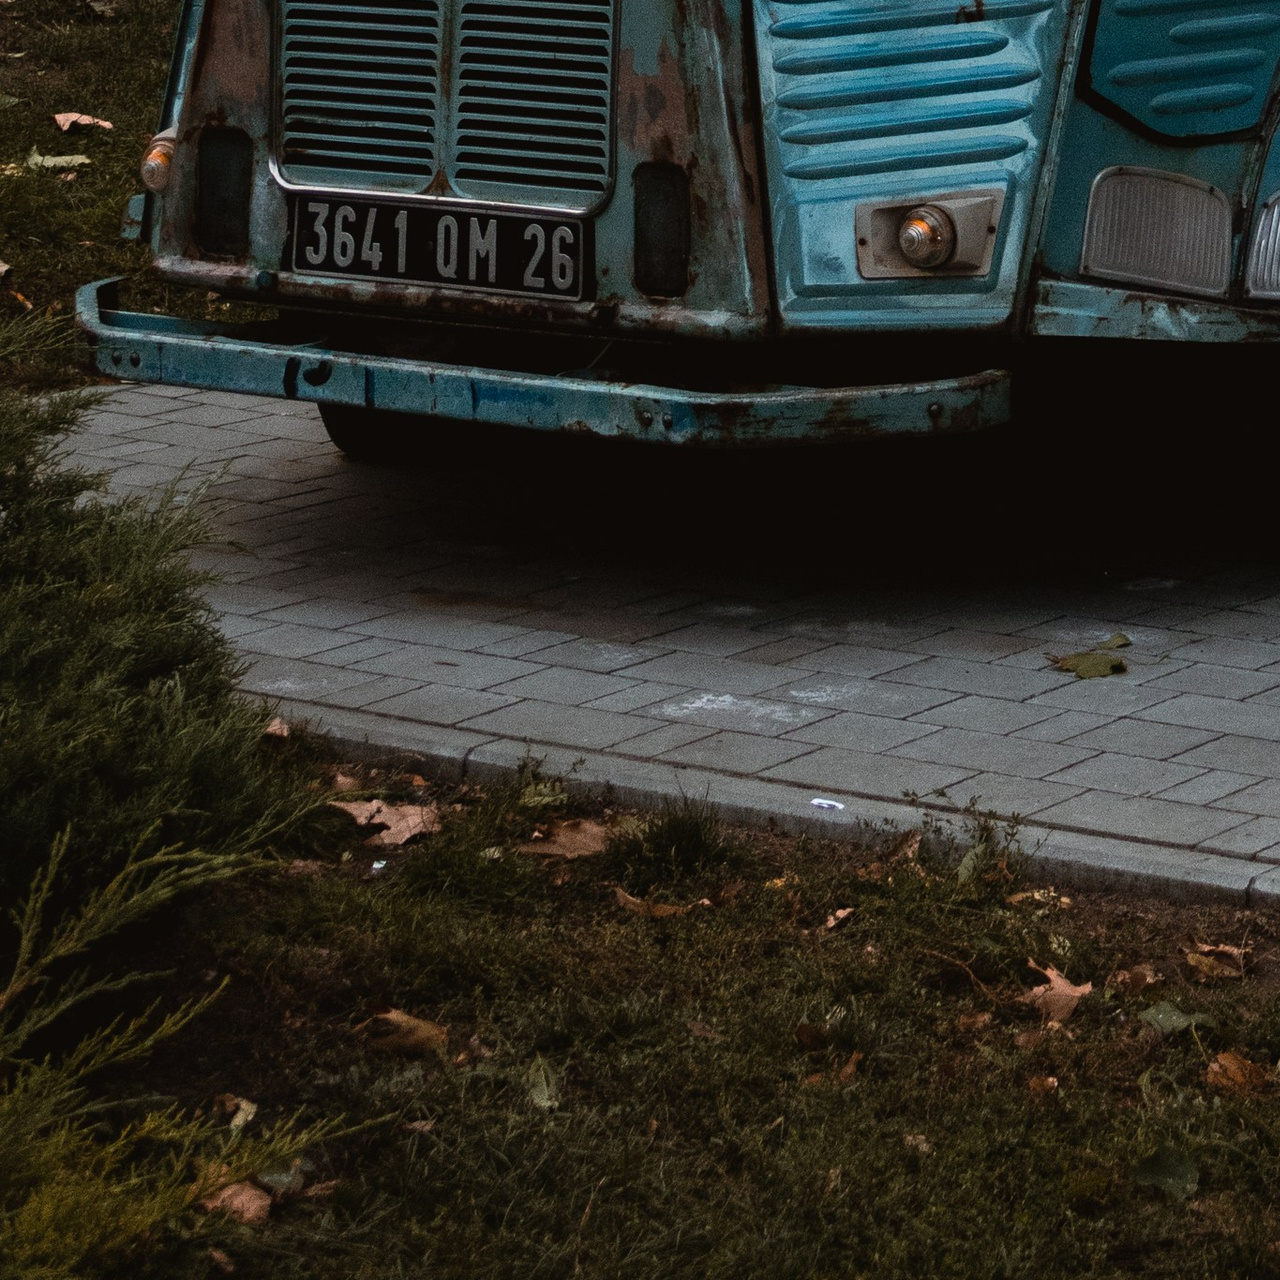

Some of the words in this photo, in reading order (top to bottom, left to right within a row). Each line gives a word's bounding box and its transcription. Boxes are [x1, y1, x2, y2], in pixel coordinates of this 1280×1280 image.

[305, 202, 408, 273] 3641
[436, 215, 497, 283] QM
[523, 223, 574, 290] 26
